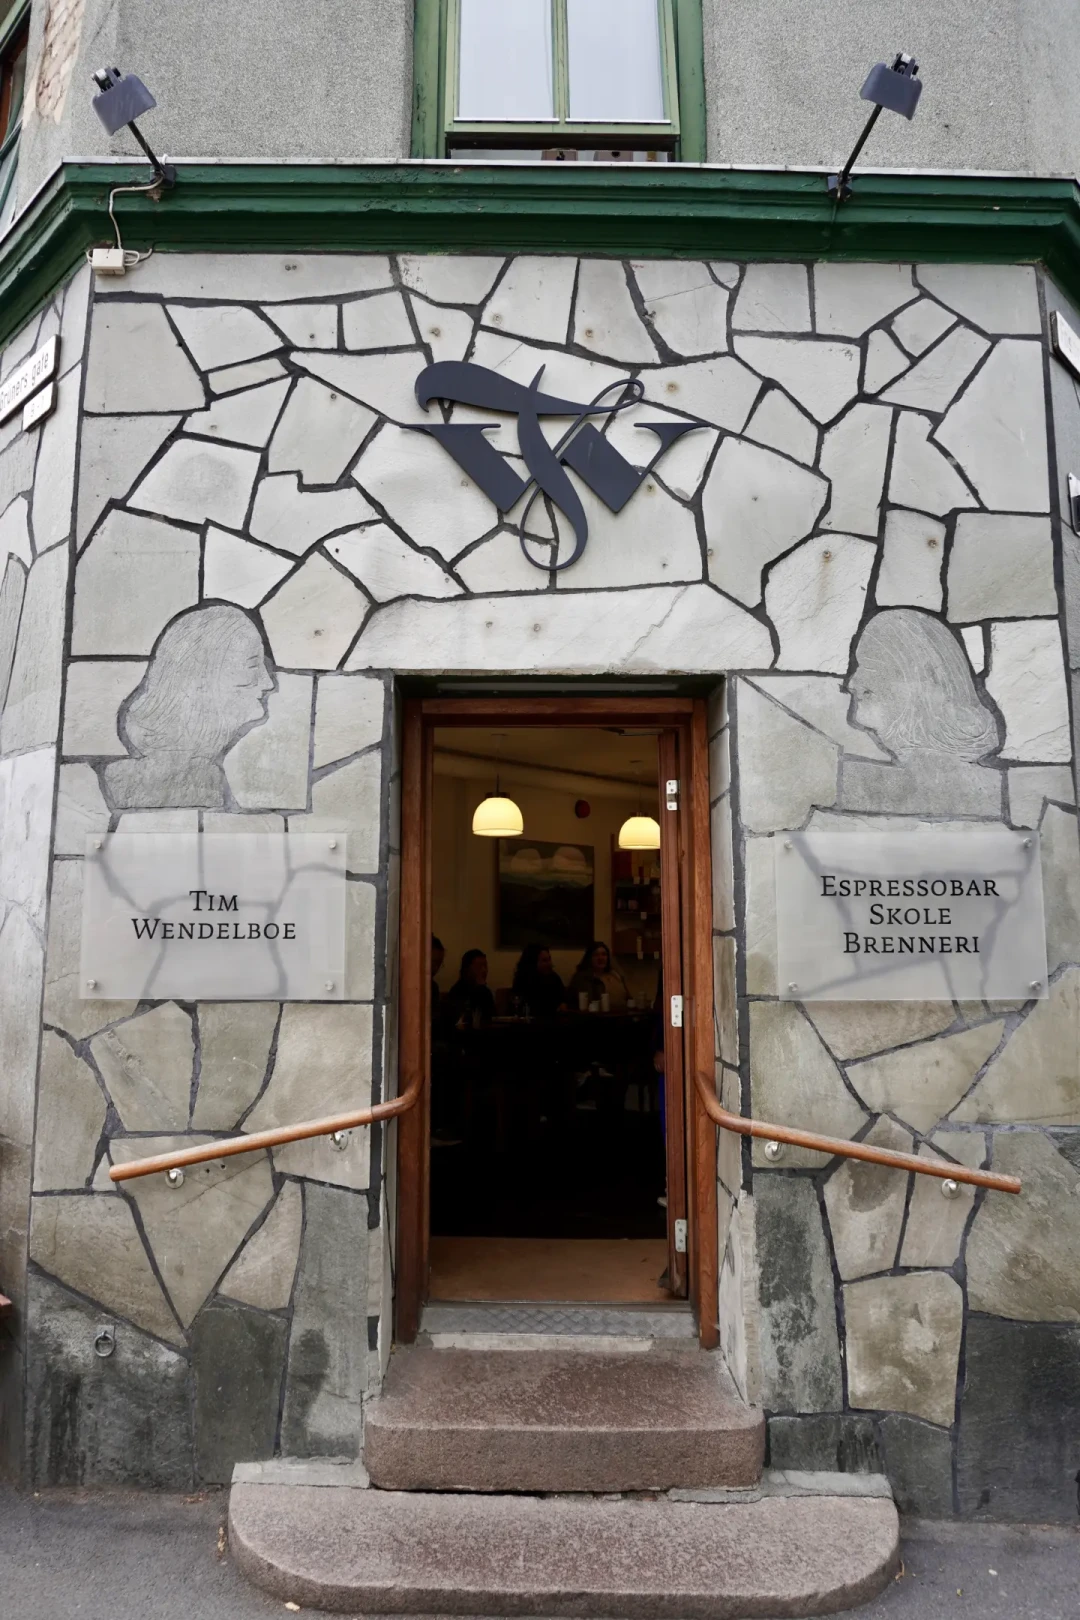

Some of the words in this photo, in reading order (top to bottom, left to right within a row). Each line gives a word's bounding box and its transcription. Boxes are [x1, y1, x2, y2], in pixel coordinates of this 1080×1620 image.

[31, 352, 49, 387] gate
[820, 875, 999, 897] ESPRESSOBAR
[189, 890, 239, 911] TIM
[869, 903, 952, 925] SKOLE
[131, 918, 296, 939] WENDELBOE
[843, 932, 980, 953] BRENNERI
